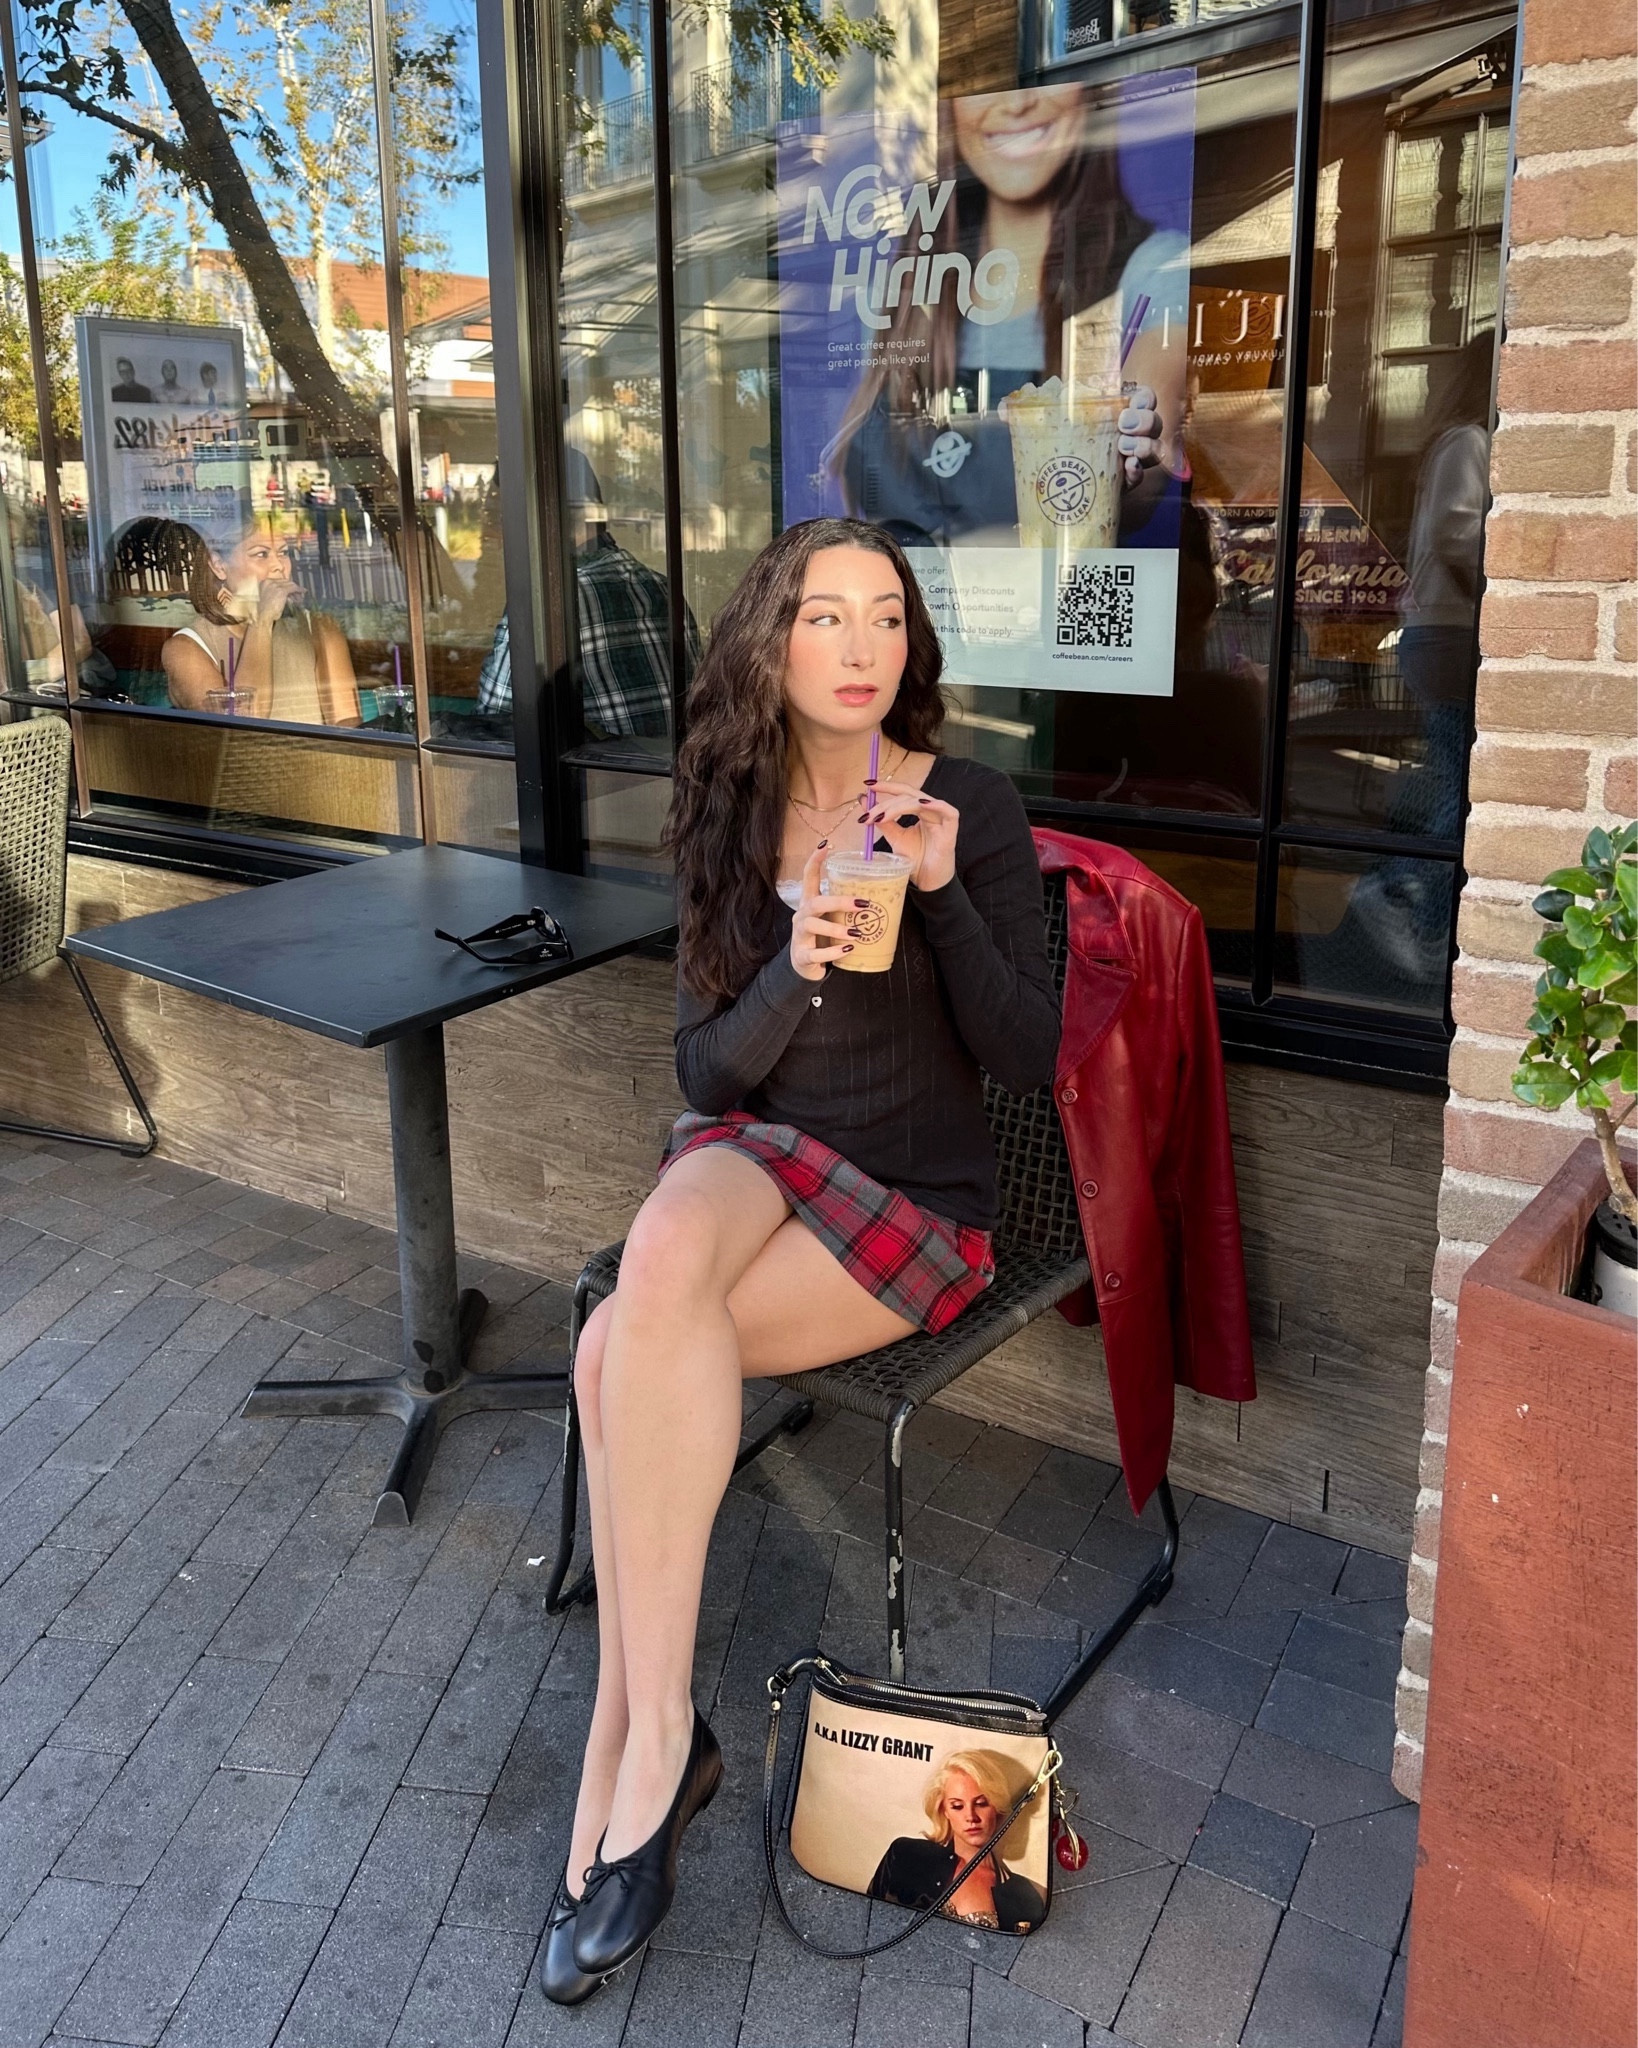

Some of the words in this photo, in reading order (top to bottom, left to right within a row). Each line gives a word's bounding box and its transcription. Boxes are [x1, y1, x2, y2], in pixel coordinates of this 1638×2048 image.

[829, 233, 1020, 330] Hiring
[827, 342, 854, 352] Great
[855, 339, 885, 351] coffee
[886, 337, 926, 351] requires
[827, 358, 852, 371] great
[854, 354, 887, 368] people
[889, 353, 906, 365] like
[908, 352, 930, 367] you!
[1039, 462, 1059, 495] COFFEE
[1061, 461, 1087, 475] BEAN
[1055, 512, 1072, 522] TEA
[1073, 497, 1091, 518] LEAF
[1243, 508, 1265, 518] AND
[972, 585, 1015, 596] Discounts
[1295, 589, 1343, 603] SINCE
[1350, 589, 1387, 604] 1963
[940, 624, 955, 633] this
[1052, 651, 1134, 663] coffeebean.com/careers
[814, 1721, 838, 1744] A.K.A
[841, 1728, 880, 1753] LIZZY
[882, 1736, 934, 1763] GRANT
